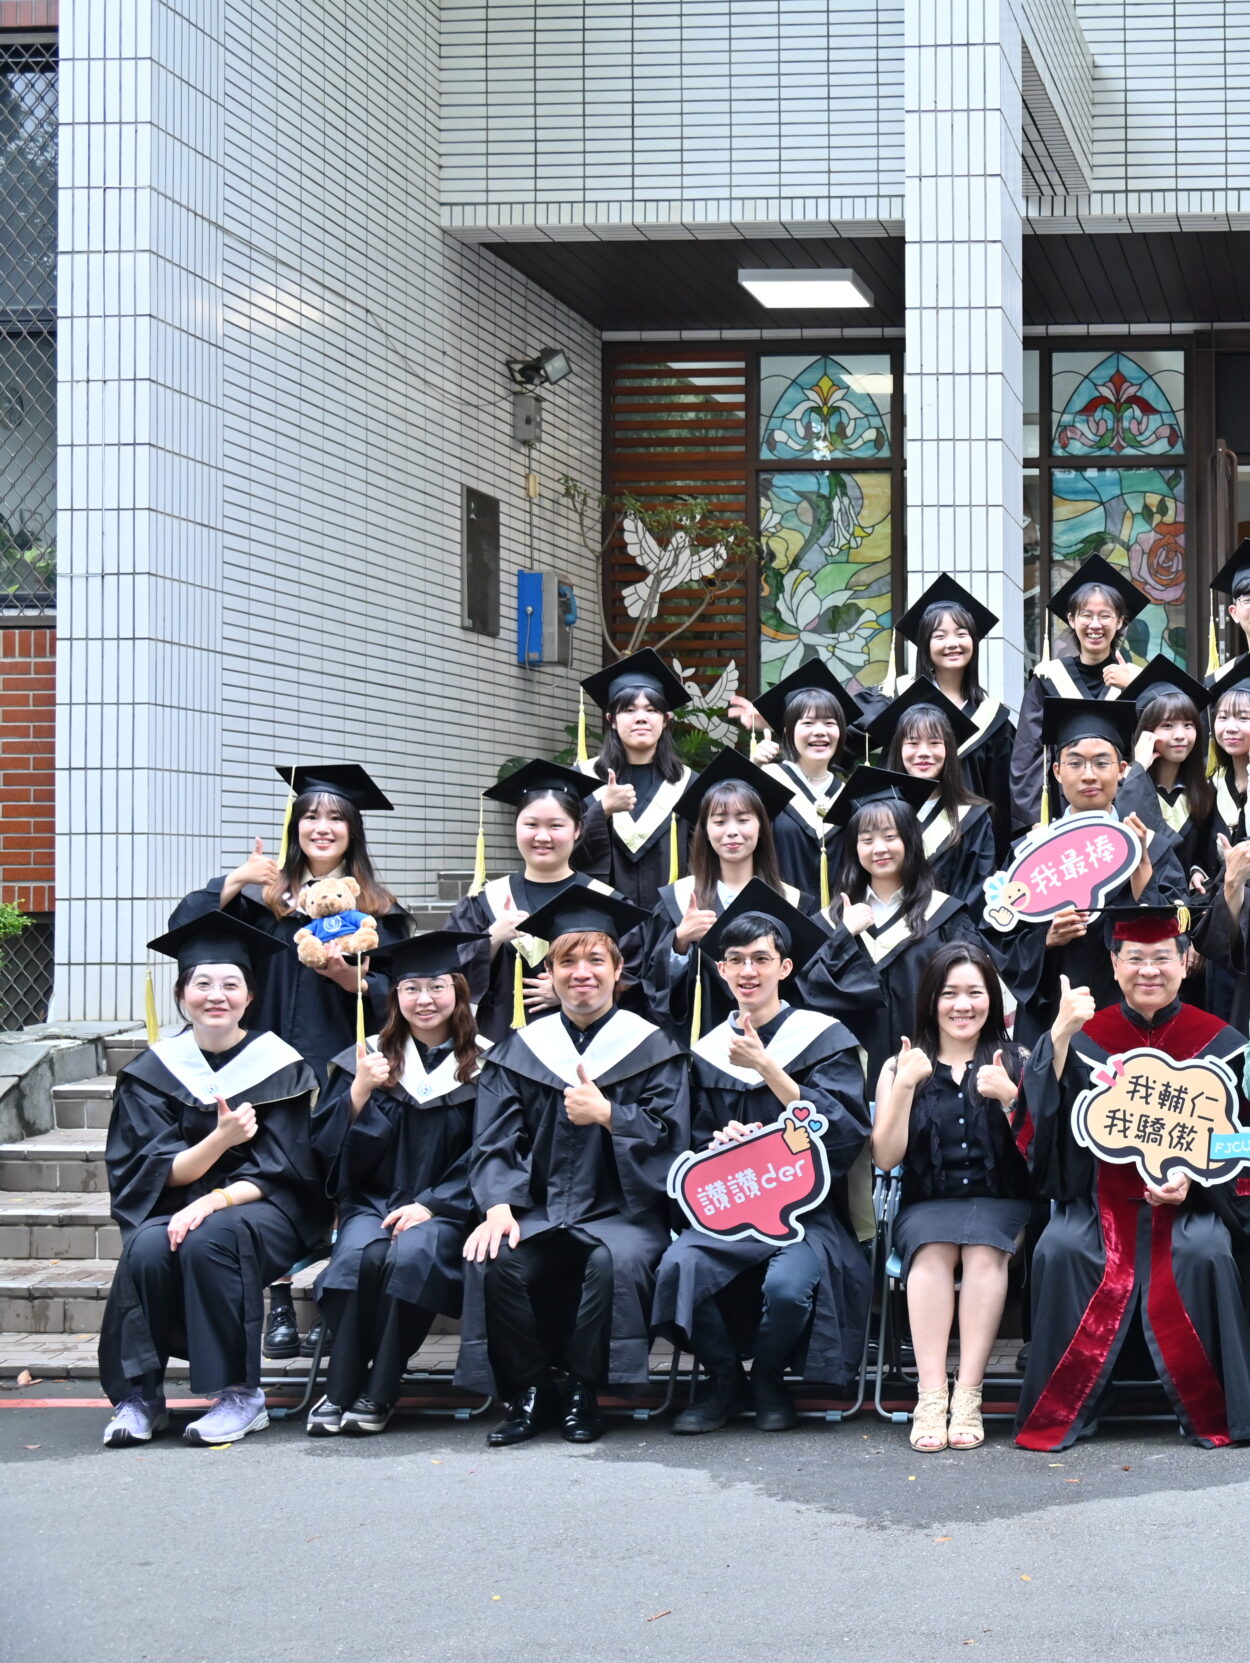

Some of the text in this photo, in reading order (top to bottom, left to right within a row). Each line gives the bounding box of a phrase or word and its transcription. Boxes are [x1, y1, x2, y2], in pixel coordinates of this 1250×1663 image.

[1029, 834, 1116, 895] 我最棒
[1125, 1074, 1219, 1123] 我輔仁
[1103, 1107, 1199, 1153] 我驕傲
